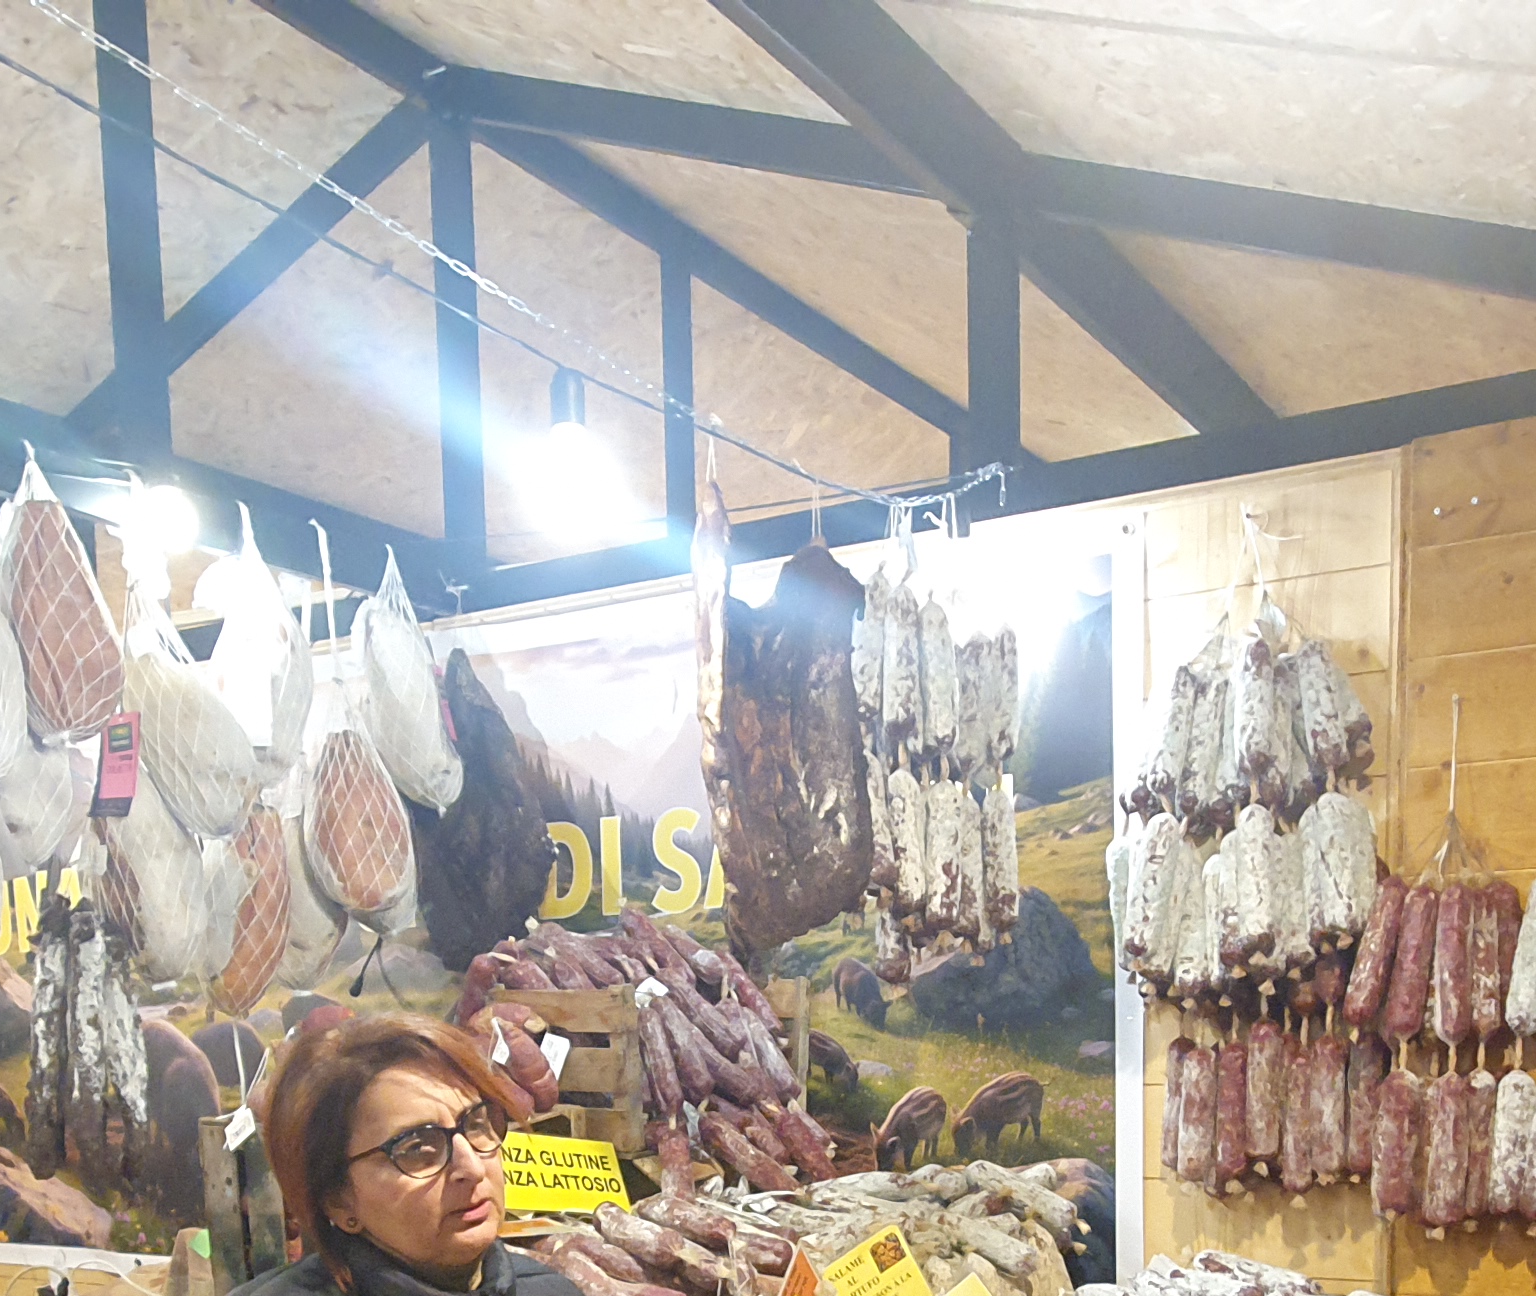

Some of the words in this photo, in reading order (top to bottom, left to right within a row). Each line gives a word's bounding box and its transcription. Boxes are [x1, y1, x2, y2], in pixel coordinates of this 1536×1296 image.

[538, 815, 623, 920] DI
[501, 1147, 537, 1165] NZA
[540, 1150, 612, 1171] GLUTINE
[504, 1170, 539, 1187] NZA
[540, 1172, 621, 1194] LATTOSIO
